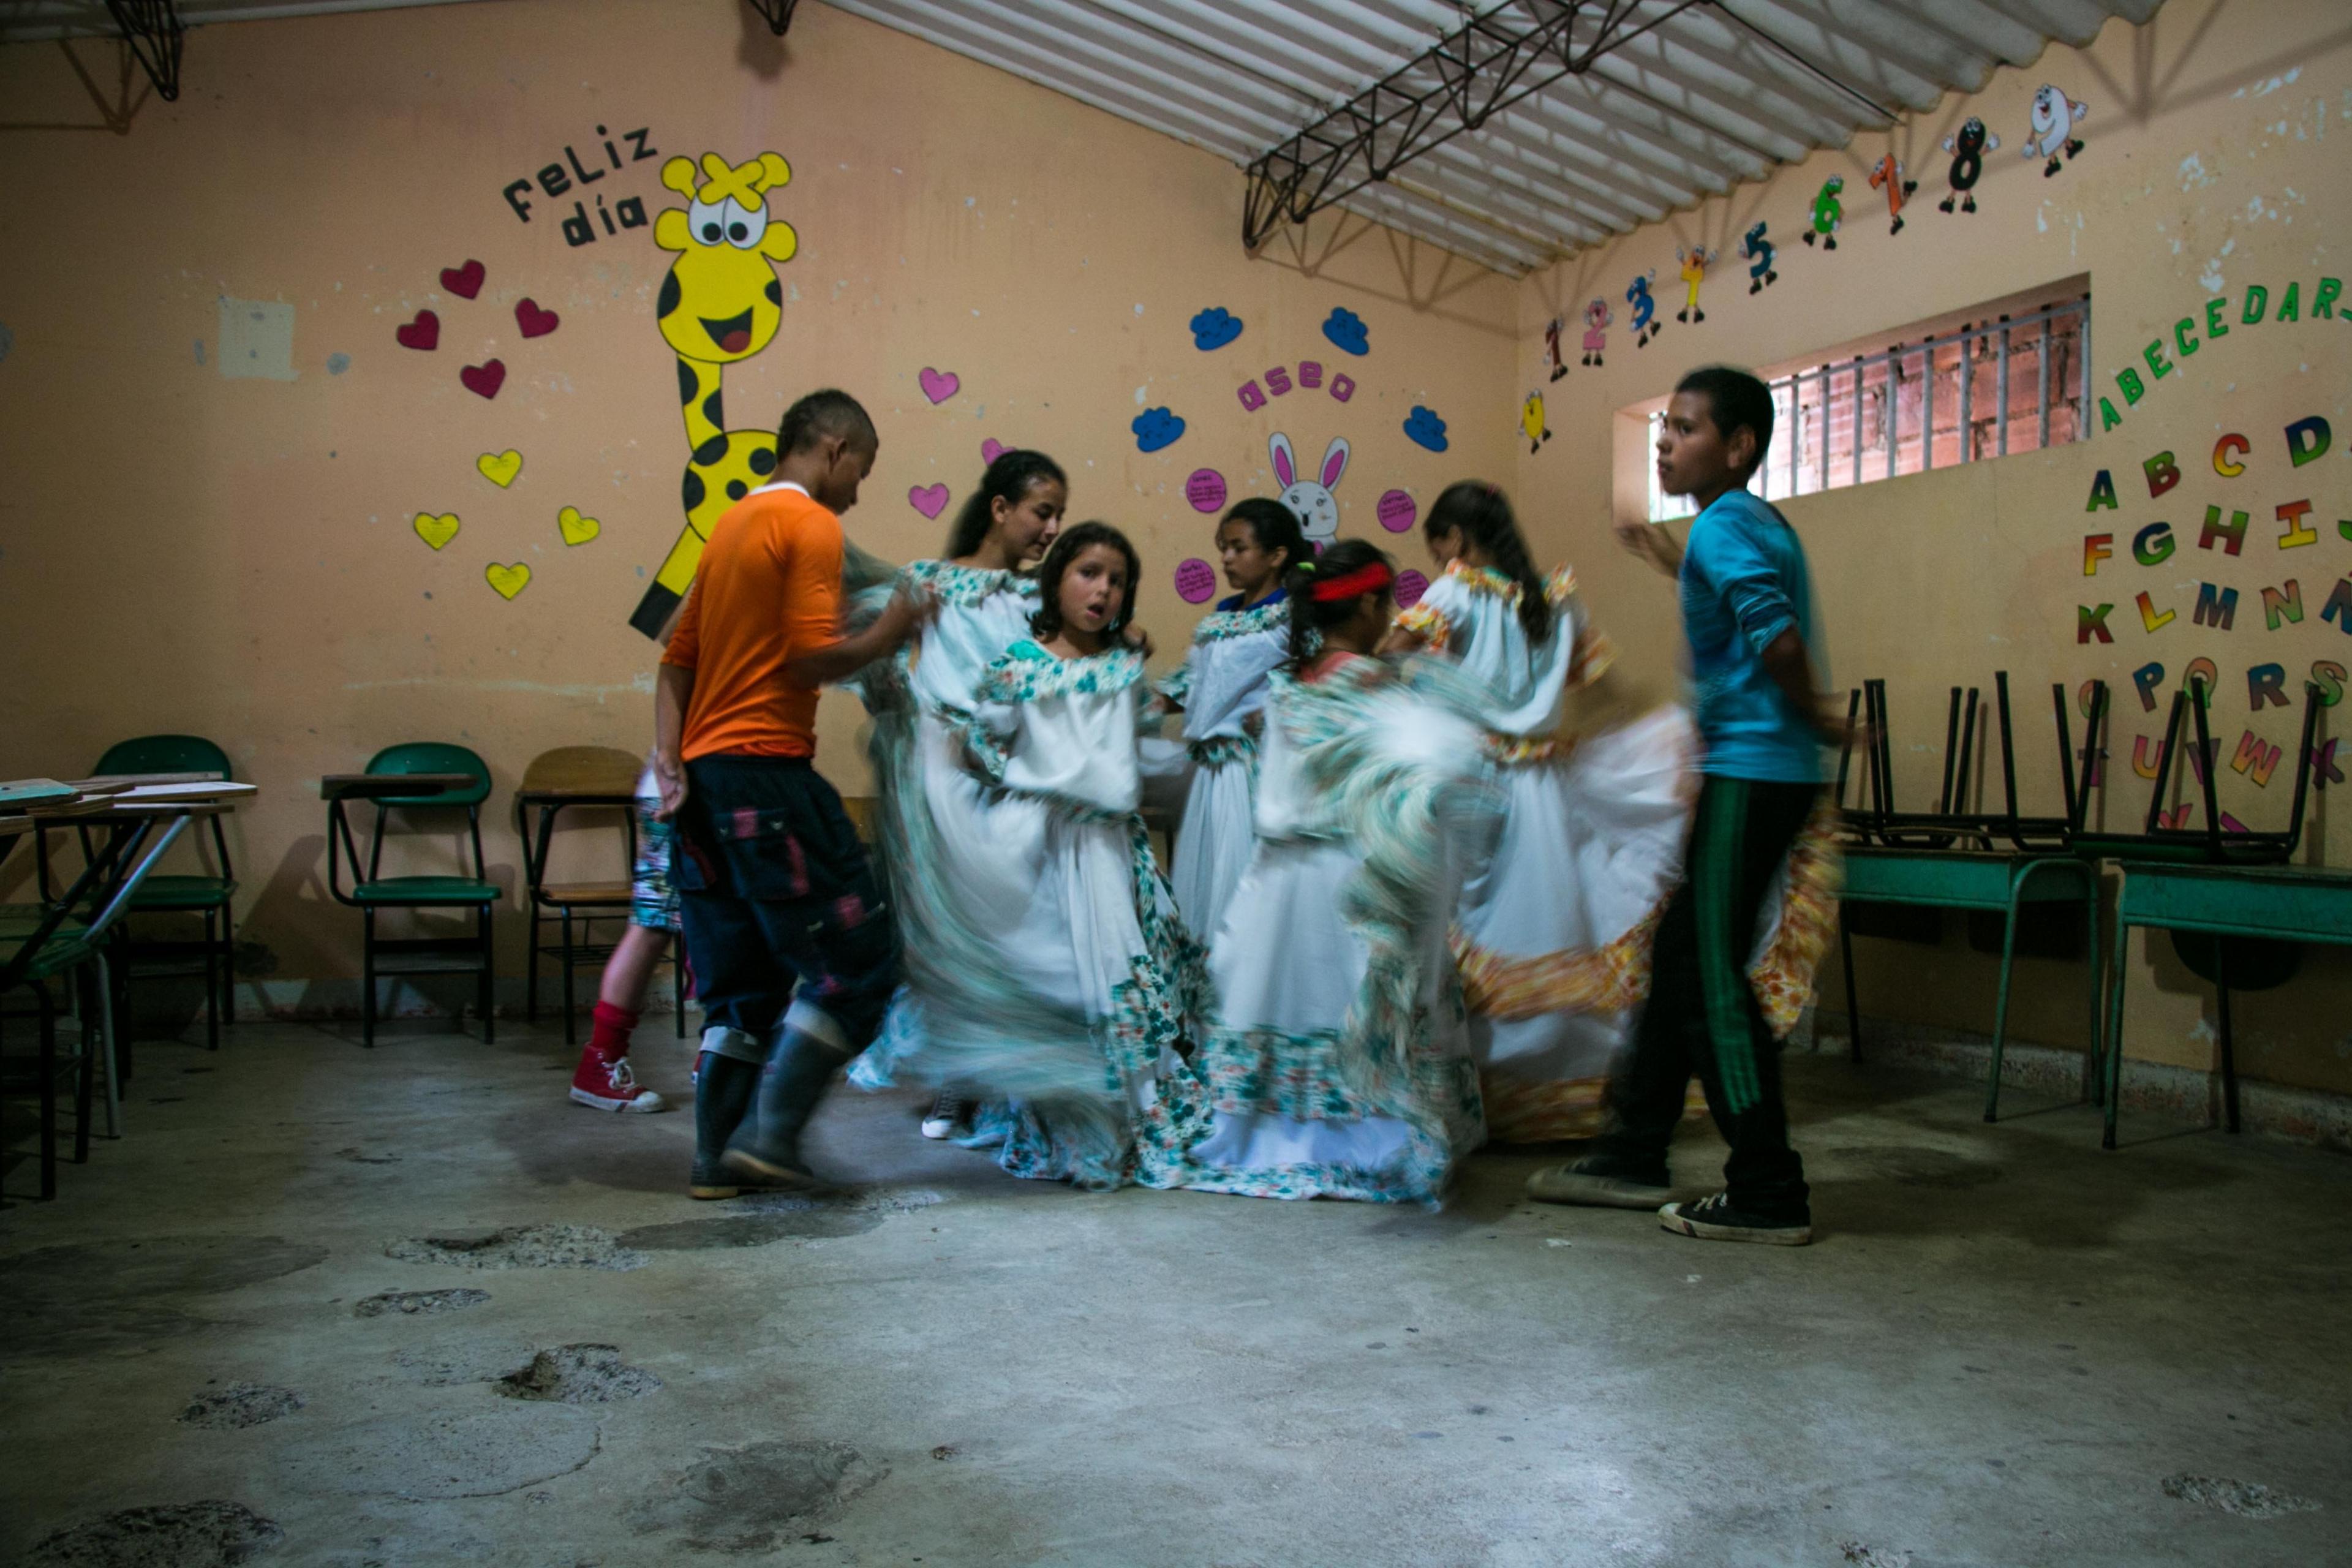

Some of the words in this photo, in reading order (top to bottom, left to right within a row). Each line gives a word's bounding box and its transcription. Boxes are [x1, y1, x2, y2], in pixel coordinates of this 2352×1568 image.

[561, 194, 649, 247] día
[2098, 277, 2352, 432] ABECEDAR
[2086, 470, 2118, 512] A
[2143, 450, 2180, 499] B
[2212, 433, 2251, 478] C
[2285, 415, 2332, 468] D
[2084, 533, 2113, 576] F
[2132, 522, 2176, 566] G
[2198, 505, 2250, 557] H
[2275, 499, 2318, 550] I
[2078, 603, 2115, 644] K
[2135, 590, 2177, 634] L
[2192, 582, 2239, 631] M
[2260, 578, 2304, 631] N
[2132, 662, 2165, 712] P
[2247, 662, 2291, 712] R
[2304, 660, 2348, 707] S
[2230, 729, 2283, 788] W
[2311, 737, 2345, 791] X
